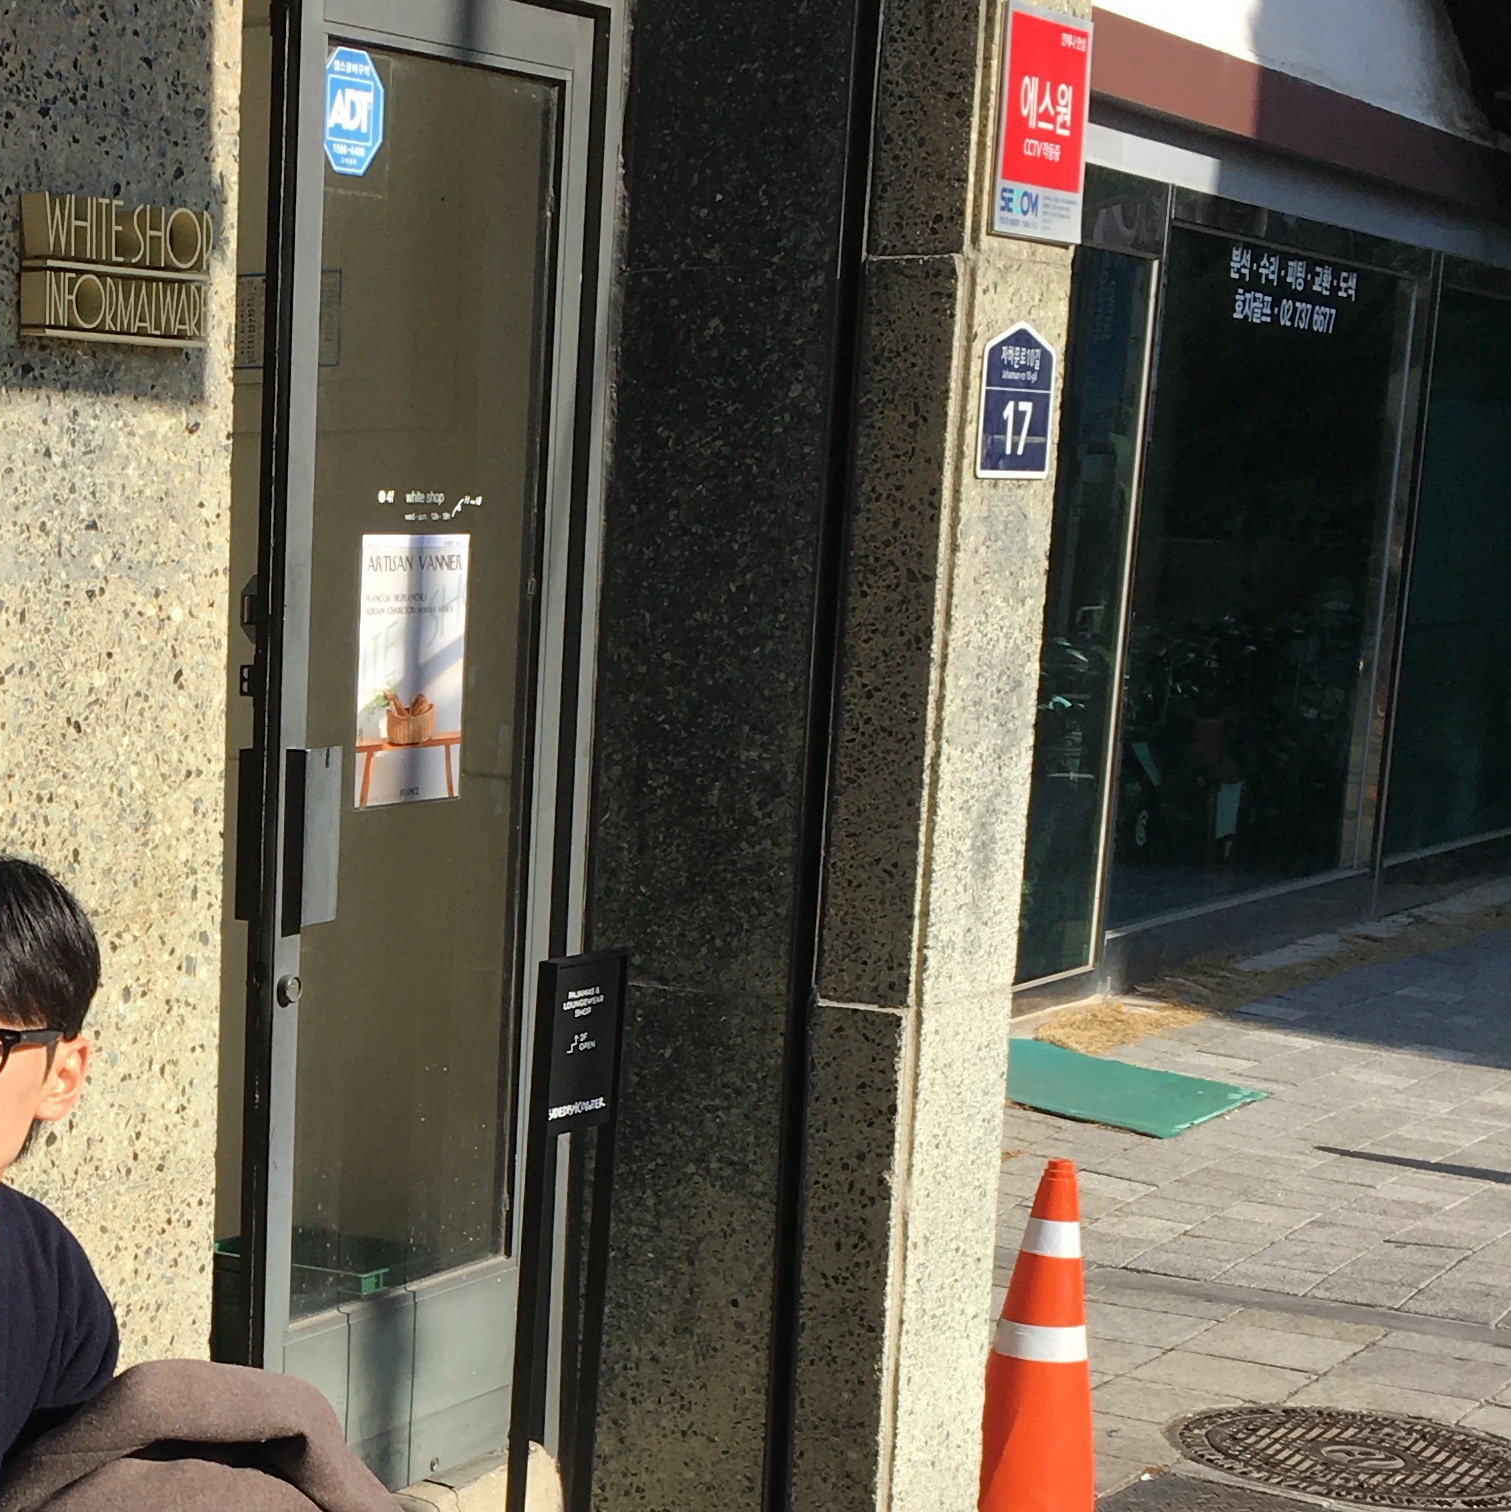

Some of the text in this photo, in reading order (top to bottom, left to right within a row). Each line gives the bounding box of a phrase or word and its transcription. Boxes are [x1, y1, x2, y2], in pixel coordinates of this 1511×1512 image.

[328, 88, 373, 132] ADT
[1020, 75, 1073, 136] 에스원
[1023, 138, 1061, 163] CCTV 작동중
[999, 186, 1039, 218] SECOM
[45, 190, 214, 272] WHITE SHOP
[1230, 246, 1251, 282] 분석
[1259, 253, 1279, 287] 수리
[1286, 259, 1306, 291] 피팅
[1337, 271, 1357, 302] 도색
[1232, 288, 1336, 334] 효자골프 02 737 6677
[1000, 345, 1042, 370] 자하문로10길
[1002, 400, 1033, 456] 17
[405, 490, 425, 504] white
[426, 490, 445, 505] shop
[367, 554, 412, 572] ARTISAN
[574, 1007, 592, 1017] SHOP
[579, 1041, 596, 1051] OPEN
